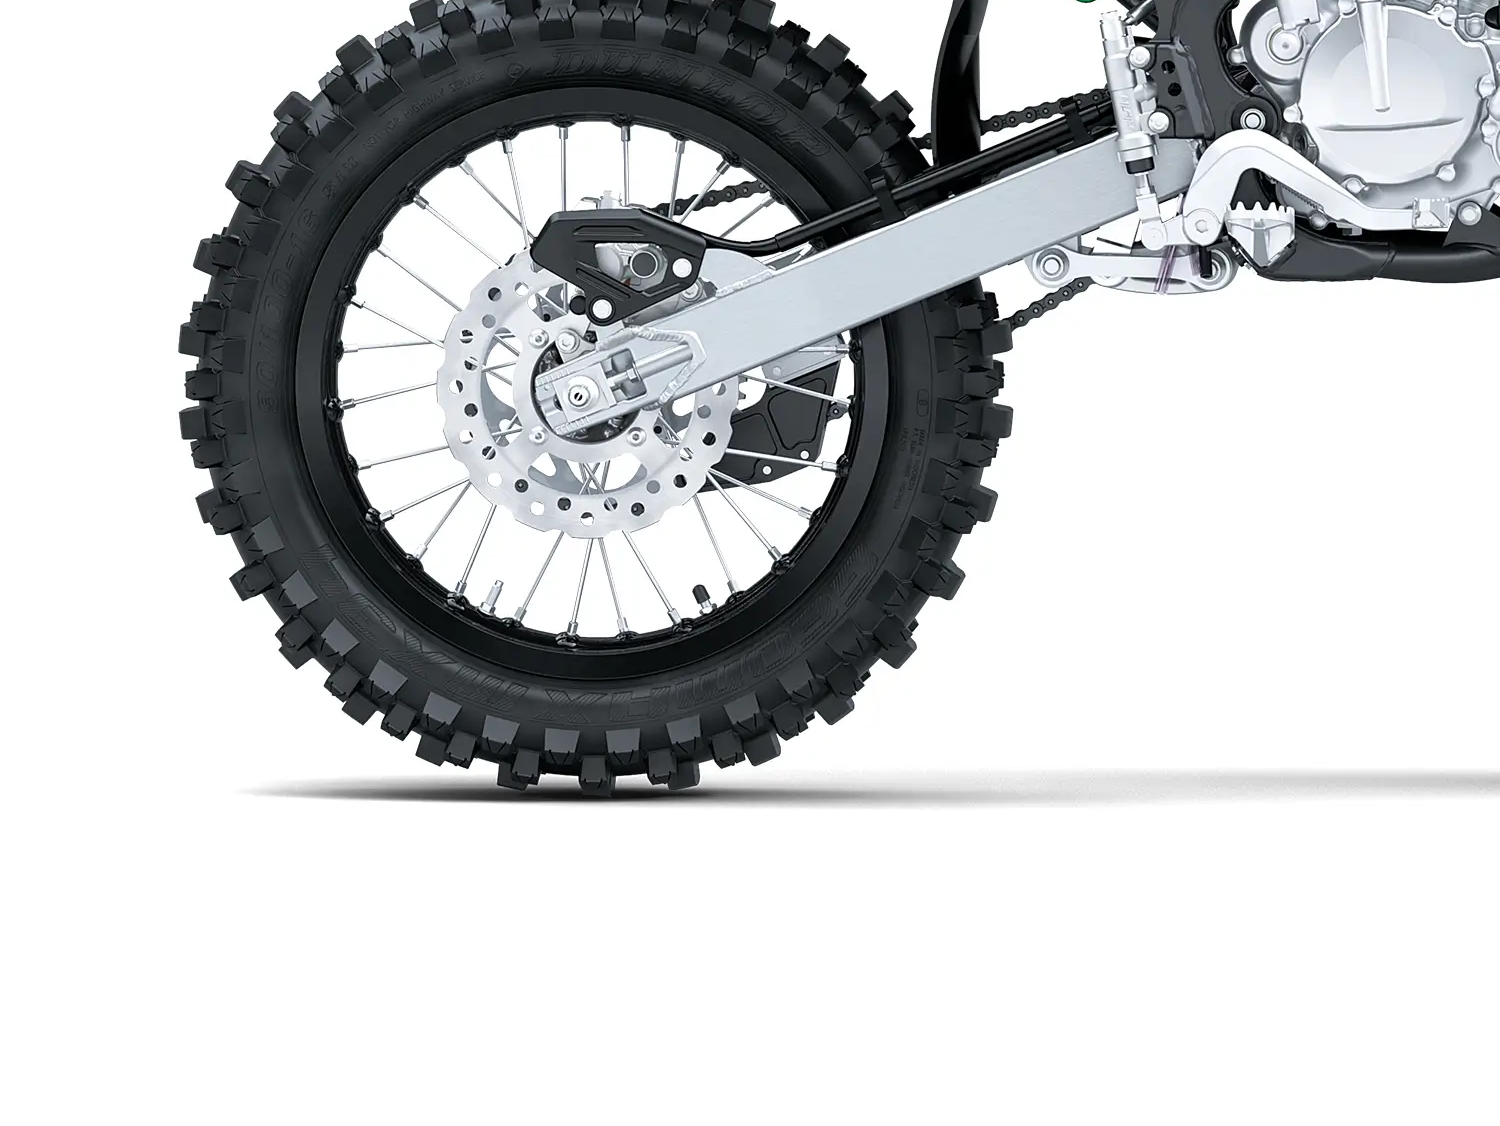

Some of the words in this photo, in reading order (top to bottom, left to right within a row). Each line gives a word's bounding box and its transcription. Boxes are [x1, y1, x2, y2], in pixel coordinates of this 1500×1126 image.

[401, 86, 446, 120] HIGHWAY
[448, 69, 487, 93] SERVICE
[545, 48, 831, 158] DUNLOP
